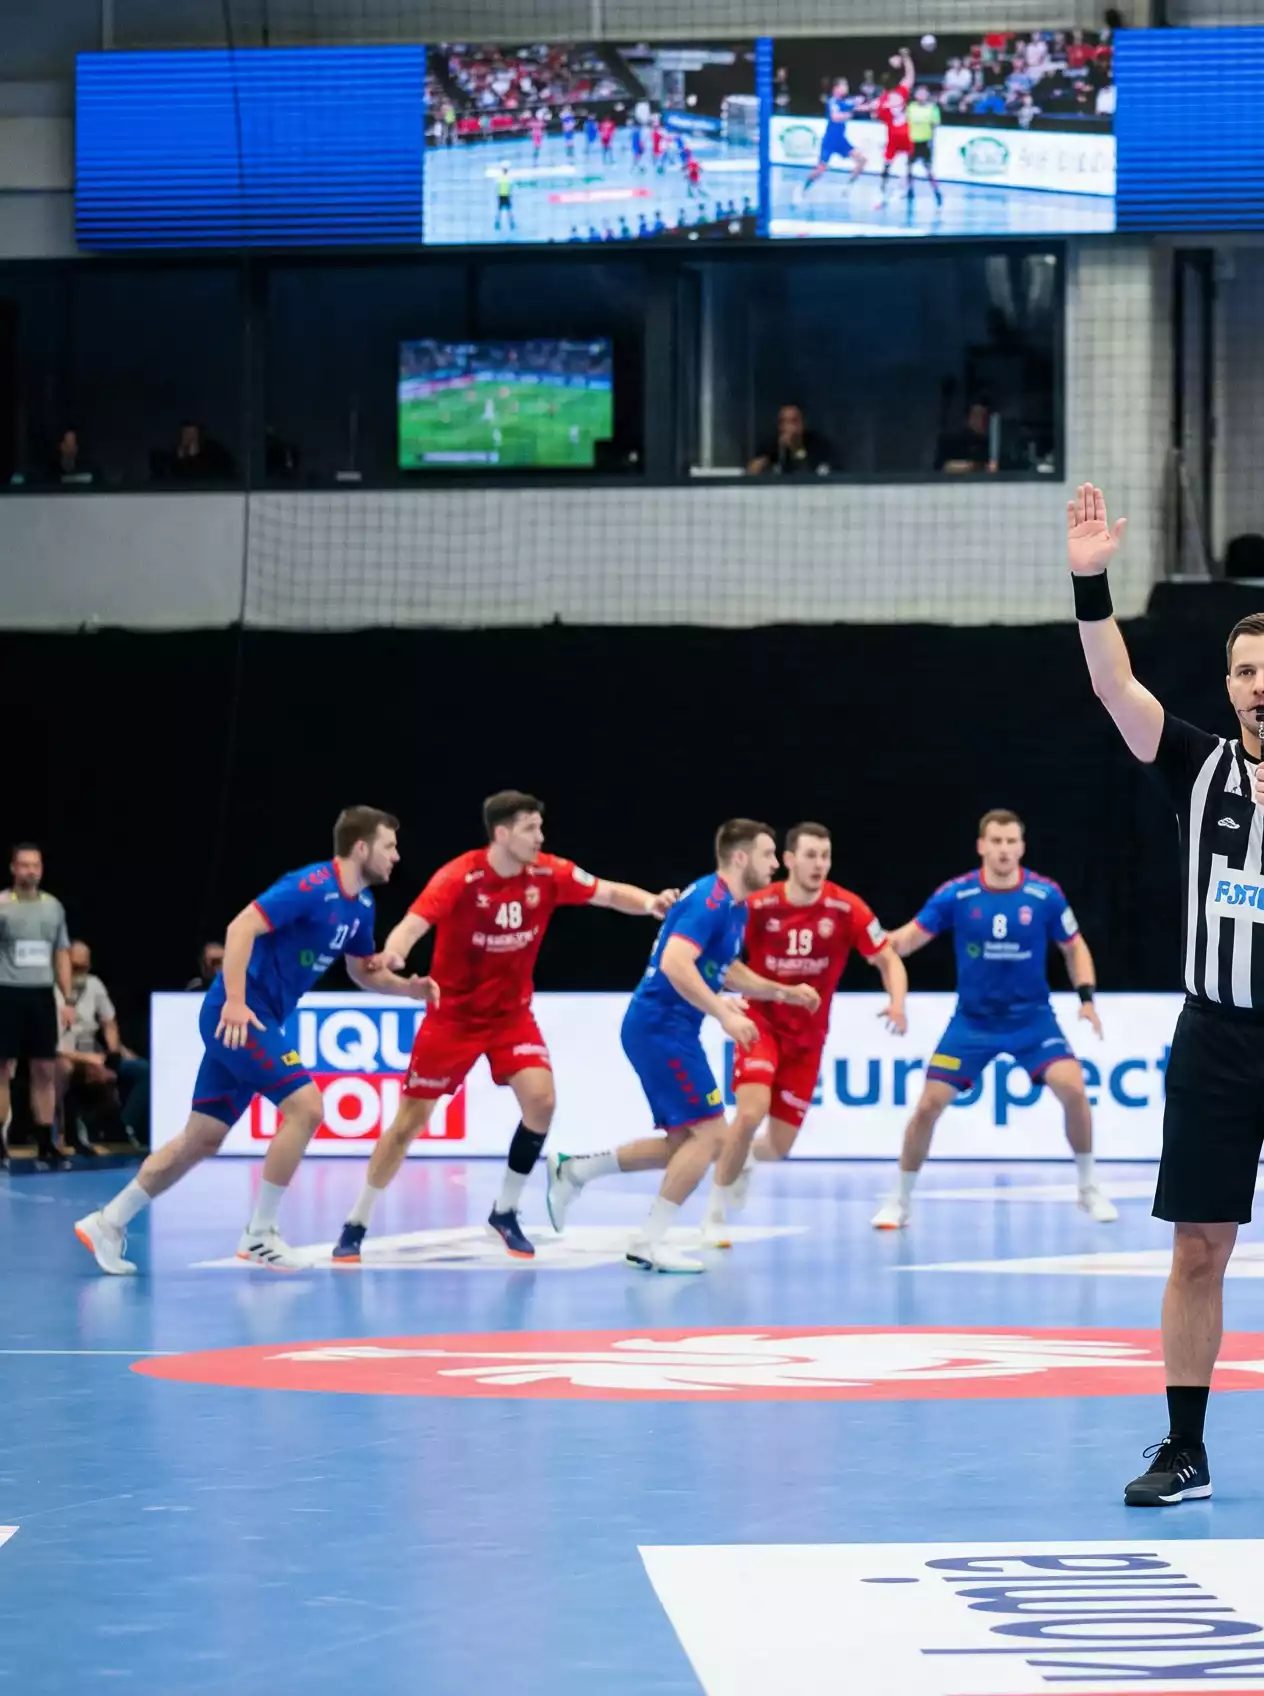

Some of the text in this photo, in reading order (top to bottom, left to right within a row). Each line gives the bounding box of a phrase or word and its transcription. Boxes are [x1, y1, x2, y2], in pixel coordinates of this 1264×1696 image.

[494, 900, 523, 930] 48
[991, 912, 1008, 940] 8
[785, 927, 814, 957] 19
